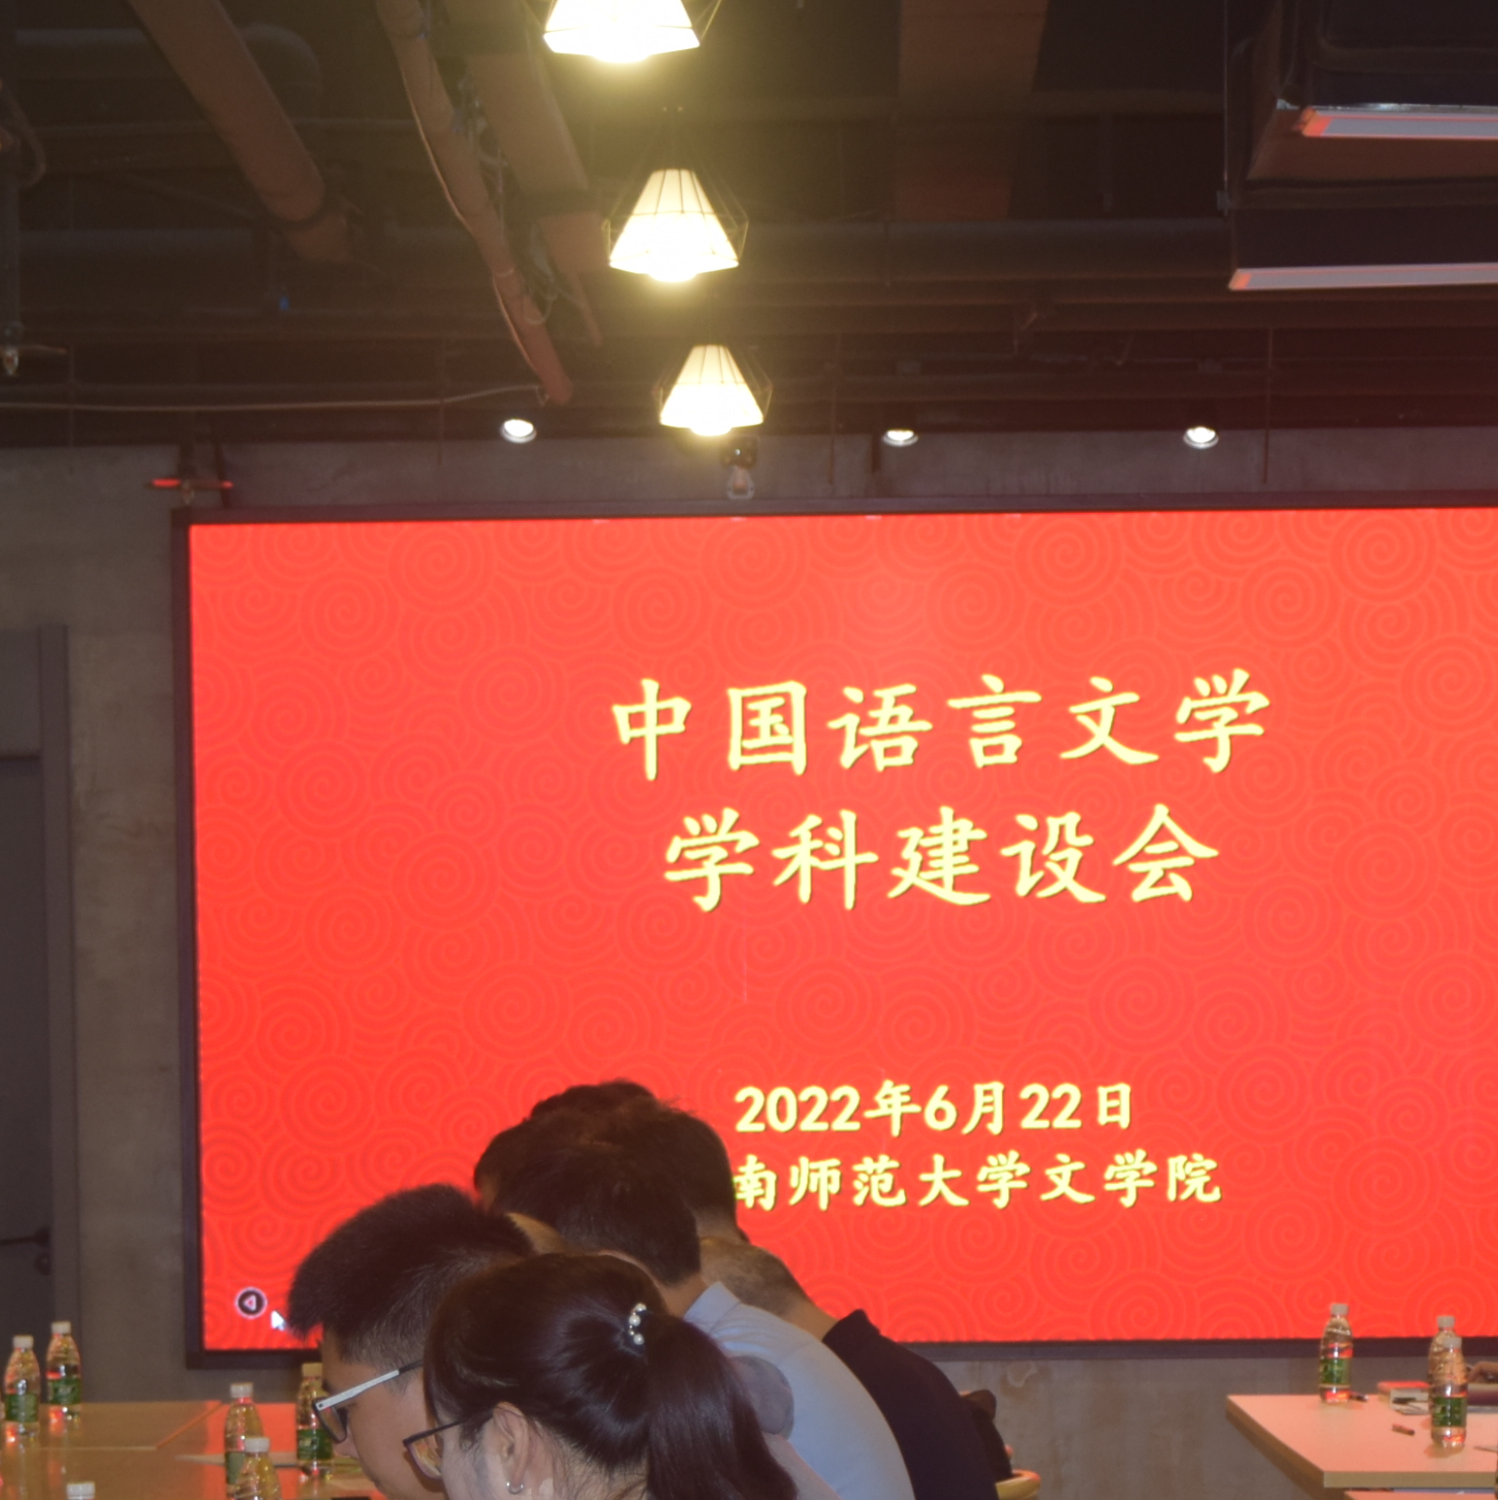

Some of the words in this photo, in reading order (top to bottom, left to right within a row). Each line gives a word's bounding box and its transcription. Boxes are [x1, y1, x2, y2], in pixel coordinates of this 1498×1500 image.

[611, 667, 1270, 781] 中国语言文学
[664, 803, 1219, 912] 学科建设会
[734, 1079, 1131, 1137] 2022年6月22日
